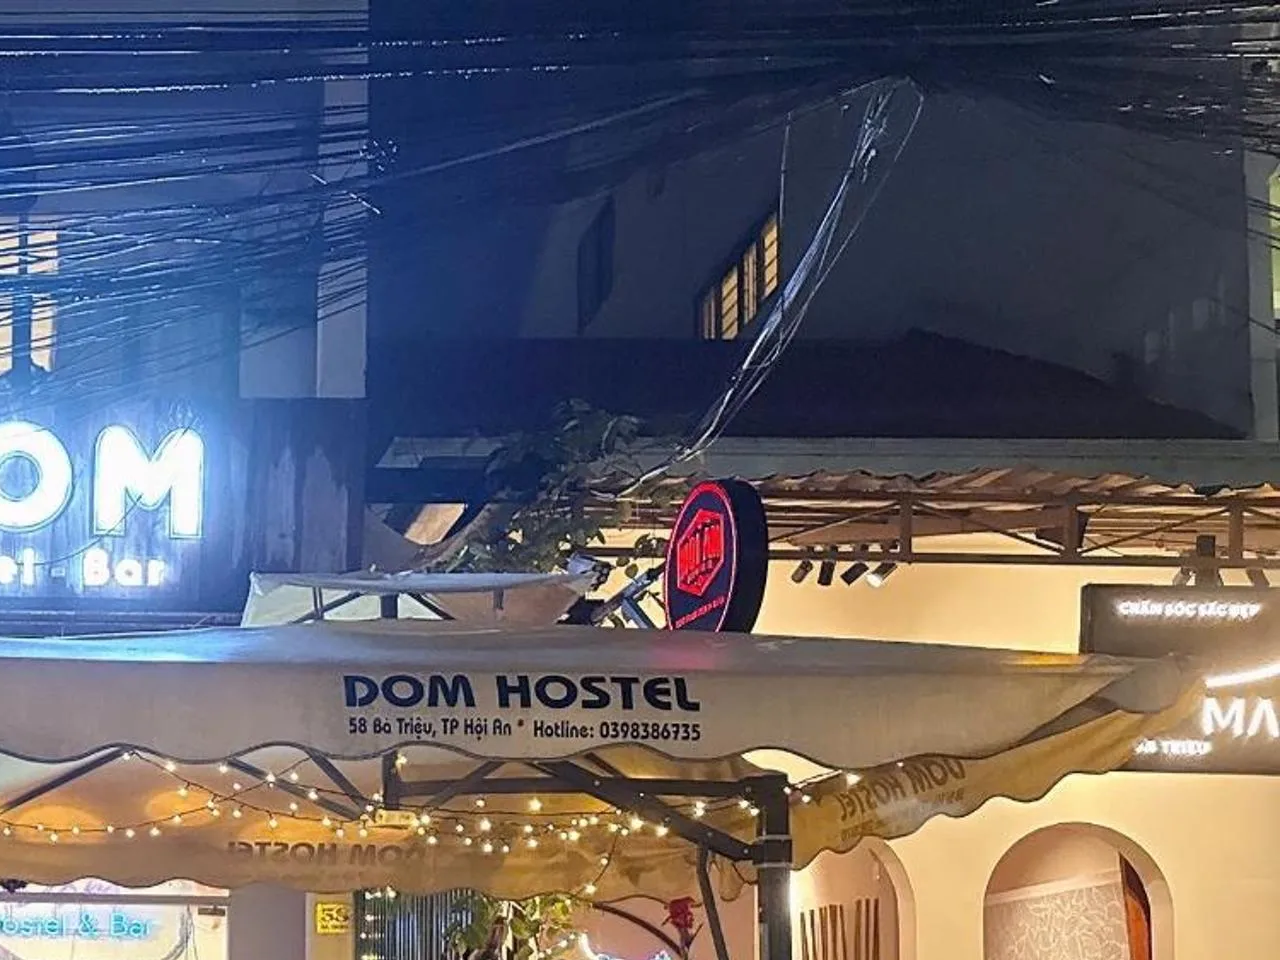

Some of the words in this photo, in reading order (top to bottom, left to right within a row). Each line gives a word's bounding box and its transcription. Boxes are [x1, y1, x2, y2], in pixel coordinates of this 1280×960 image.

[83, 547, 167, 587] Bar
[343, 674, 476, 708] DOM
[495, 674, 701, 712] HOSTEL
[349, 717, 368, 735] 58
[396, 716, 437, 740] Triệu,
[441, 717, 460, 736] TP
[463, 718, 488, 741] Hội
[492, 717, 512, 736] An
[533, 719, 595, 739] Hotline:
[599, 721, 701, 741] 0398386735
[79, 910, 97, 936] &
[111, 910, 151, 937] Bar
